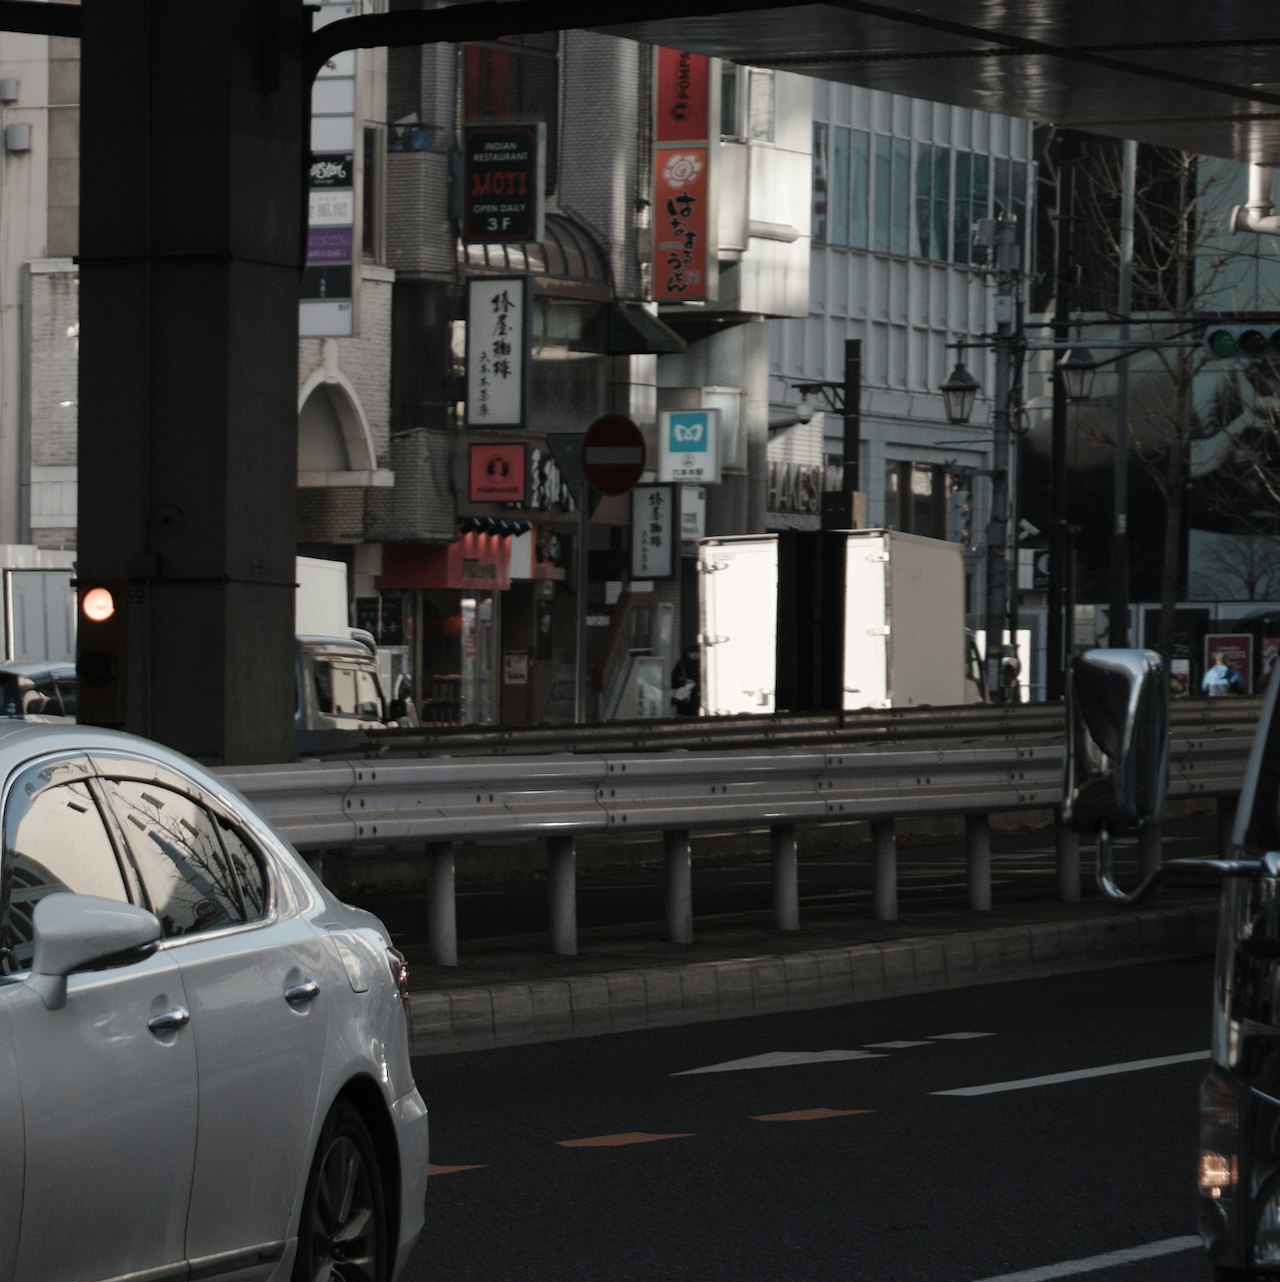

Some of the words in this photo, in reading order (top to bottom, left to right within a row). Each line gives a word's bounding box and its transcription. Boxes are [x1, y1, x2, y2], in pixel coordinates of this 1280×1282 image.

[484, 141, 517, 151] INDIAN
[473, 151, 528, 161] RESTAURANT
[471, 170, 529, 198] MOTI
[473, 204, 498, 214] OPEN
[500, 203, 527, 213] DAILY
